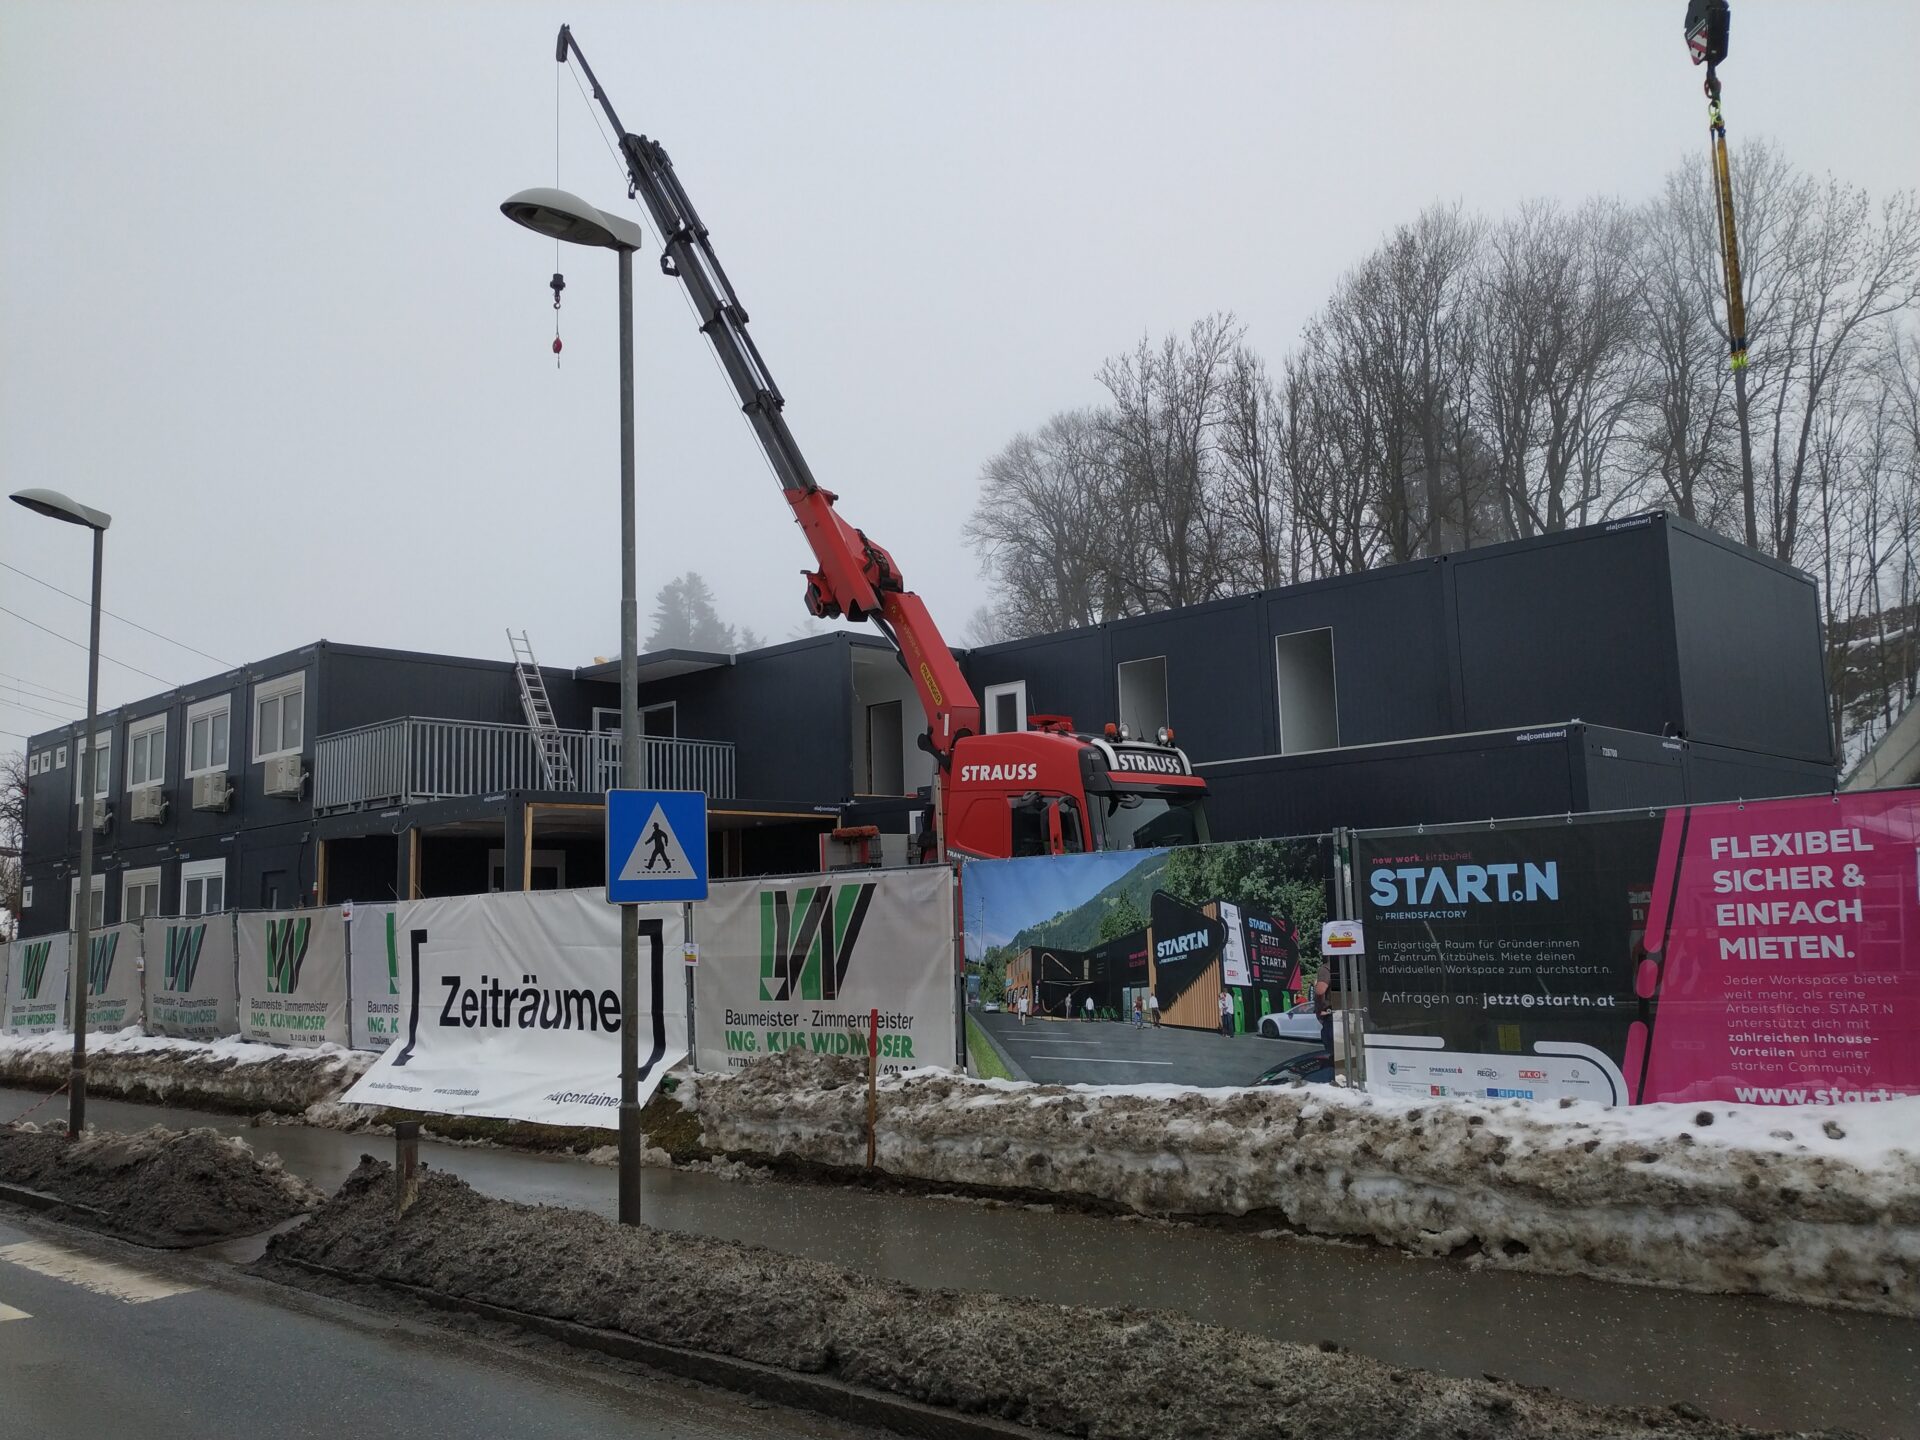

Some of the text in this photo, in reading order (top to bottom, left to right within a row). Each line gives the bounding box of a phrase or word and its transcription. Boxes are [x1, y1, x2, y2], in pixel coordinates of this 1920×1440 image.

[1605, 516, 1651, 531] ela[container]
[1516, 729, 1566, 741] ela[container]
[1119, 754, 1181, 774] STRAUSS
[961, 763, 1037, 782] STRAUSS
[1710, 828, 1874, 860] FLEXIBEL
[1395, 853, 1424, 863] work.
[1713, 863, 1866, 893] SICHER &
[1385, 910, 1468, 920] FRIENDSFACTORY
[1716, 899, 1864, 927] EINFACH
[1260, 934, 1279, 947] JETZT
[1377, 939, 1580, 953] Einzigartiger Raum für Gründer:innen
[1719, 935, 1855, 960] MIETEN.
[1378, 953, 1391, 962] im
[1393, 952, 1438, 962] Zentrum
[1501, 952, 1532, 961] Miete
[1536, 952, 1576, 961] deinen
[1379, 964, 1442, 974] individuellen
[1445, 964, 1505, 976] Workspace
[1509, 966, 1532, 974] zum
[1723, 973, 1900, 987] Jeder Workspace bietet
[1381, 991, 1616, 1009] Anfragen an: jetzt@startn.at
[1725, 990, 1867, 1000] weit mehr, als reine
[251, 998, 282, 1010] Baumeiste
[368, 1001, 399, 1013] Baumeis
[440, 975, 622, 1033] Zeiträume
[1726, 1003, 1894, 1014] Arbeitsfläche. START.N
[251, 1012, 268, 1026] ING.
[368, 1017, 399, 1033] ING. K
[725, 1009, 799, 1027] Baumeister
[811, 1010, 914, 1031] Zimmermeister
[1727, 1018, 1871, 1029] unterstützt dich mit
[725, 1031, 761, 1052] ING.
[1728, 1032, 1880, 1044] zahlreichen Inhouse-
[1729, 1046, 1870, 1059] Vorteilen und einer
[728, 1056, 758, 1068] KITZBÜ
[1731, 1061, 1876, 1077] starken Community.
